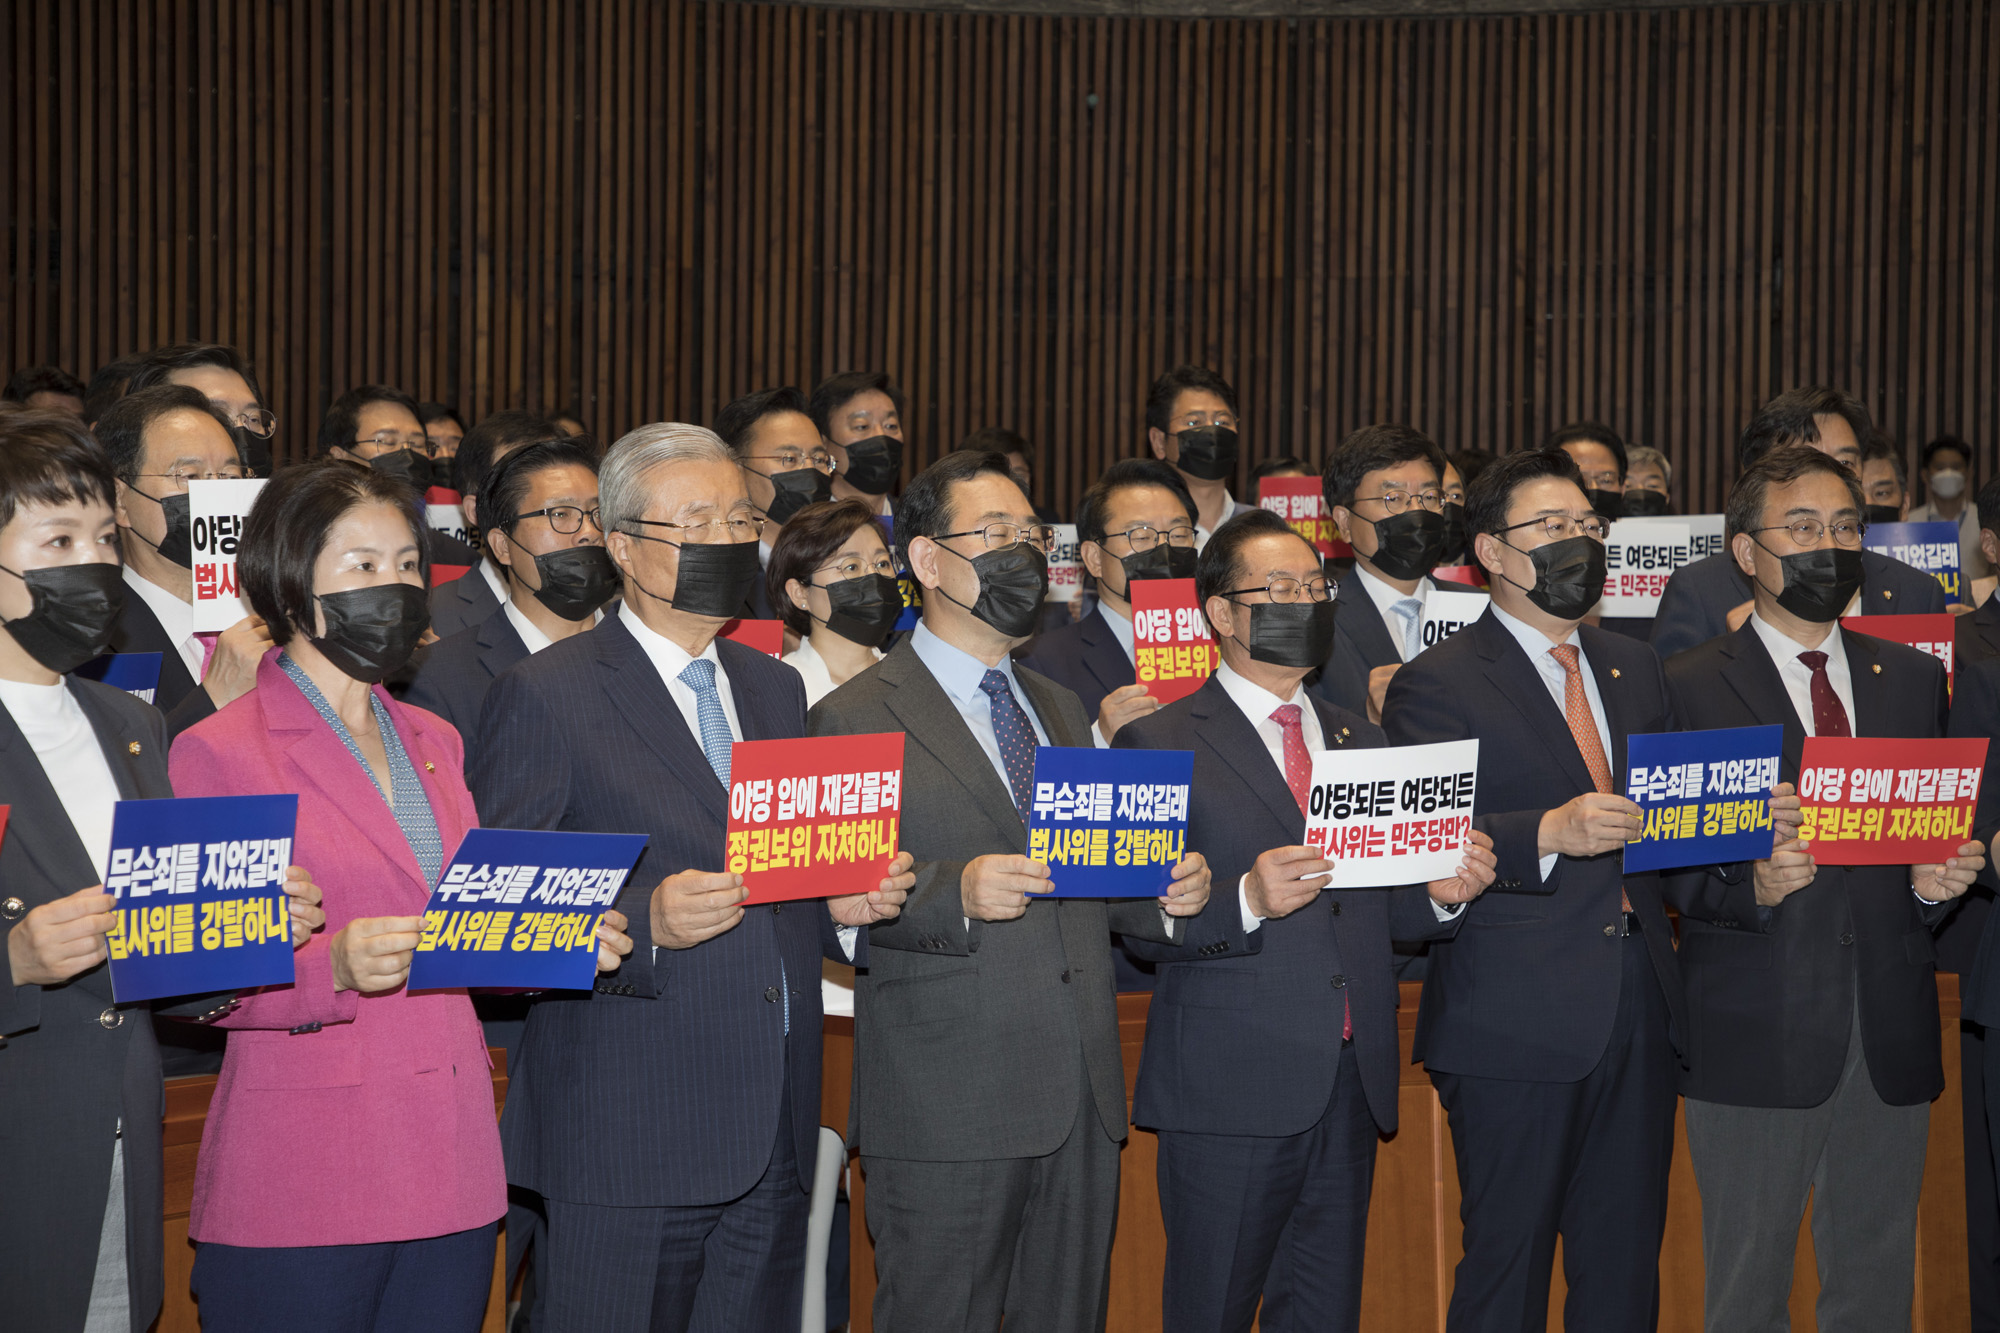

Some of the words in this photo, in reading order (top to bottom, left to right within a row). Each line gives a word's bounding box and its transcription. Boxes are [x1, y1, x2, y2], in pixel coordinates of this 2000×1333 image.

[1291, 495, 1318, 518] 입에
[193, 515, 251, 555] 야당
[1626, 545, 1688, 569] 여당되든
[1135, 608, 1172, 643] 야당
[1175, 607, 1211, 641] 입에
[1137, 645, 1211, 682] 정권보위
[731, 779, 774, 824] 야당
[777, 775, 818, 821] 입에
[819, 769, 901, 816] 재갈물려
[1310, 780, 1395, 820] 야당되든
[1401, 772, 1474, 814] 여당되든
[1629, 762, 1704, 802] 무슨죄를
[1706, 756, 1780, 796] 지었길래
[1800, 767, 1846, 802] 야당
[1849, 768, 1894, 803] 입에
[1894, 767, 1982, 803] 재갈물려
[1033, 782, 1114, 821] 무슨죄를
[1116, 784, 1189, 822] 지었길래
[1391, 815, 1471, 856] 민주당만?
[1798, 806, 1885, 841] 정권보위
[1887, 805, 1972, 841] 자처하나
[728, 825, 812, 875] 정권보위
[815, 817, 897, 866] 자처하나
[1029, 828, 1109, 866] 법사위를
[1114, 828, 1184, 866] 강탈하나
[107, 843, 200, 899] 무슨죄를
[201, 837, 292, 891] 지었길래
[437, 864, 540, 905] 무슨죄를
[530, 867, 629, 906] 지었길래
[200, 895, 289, 951] 강탈하나
